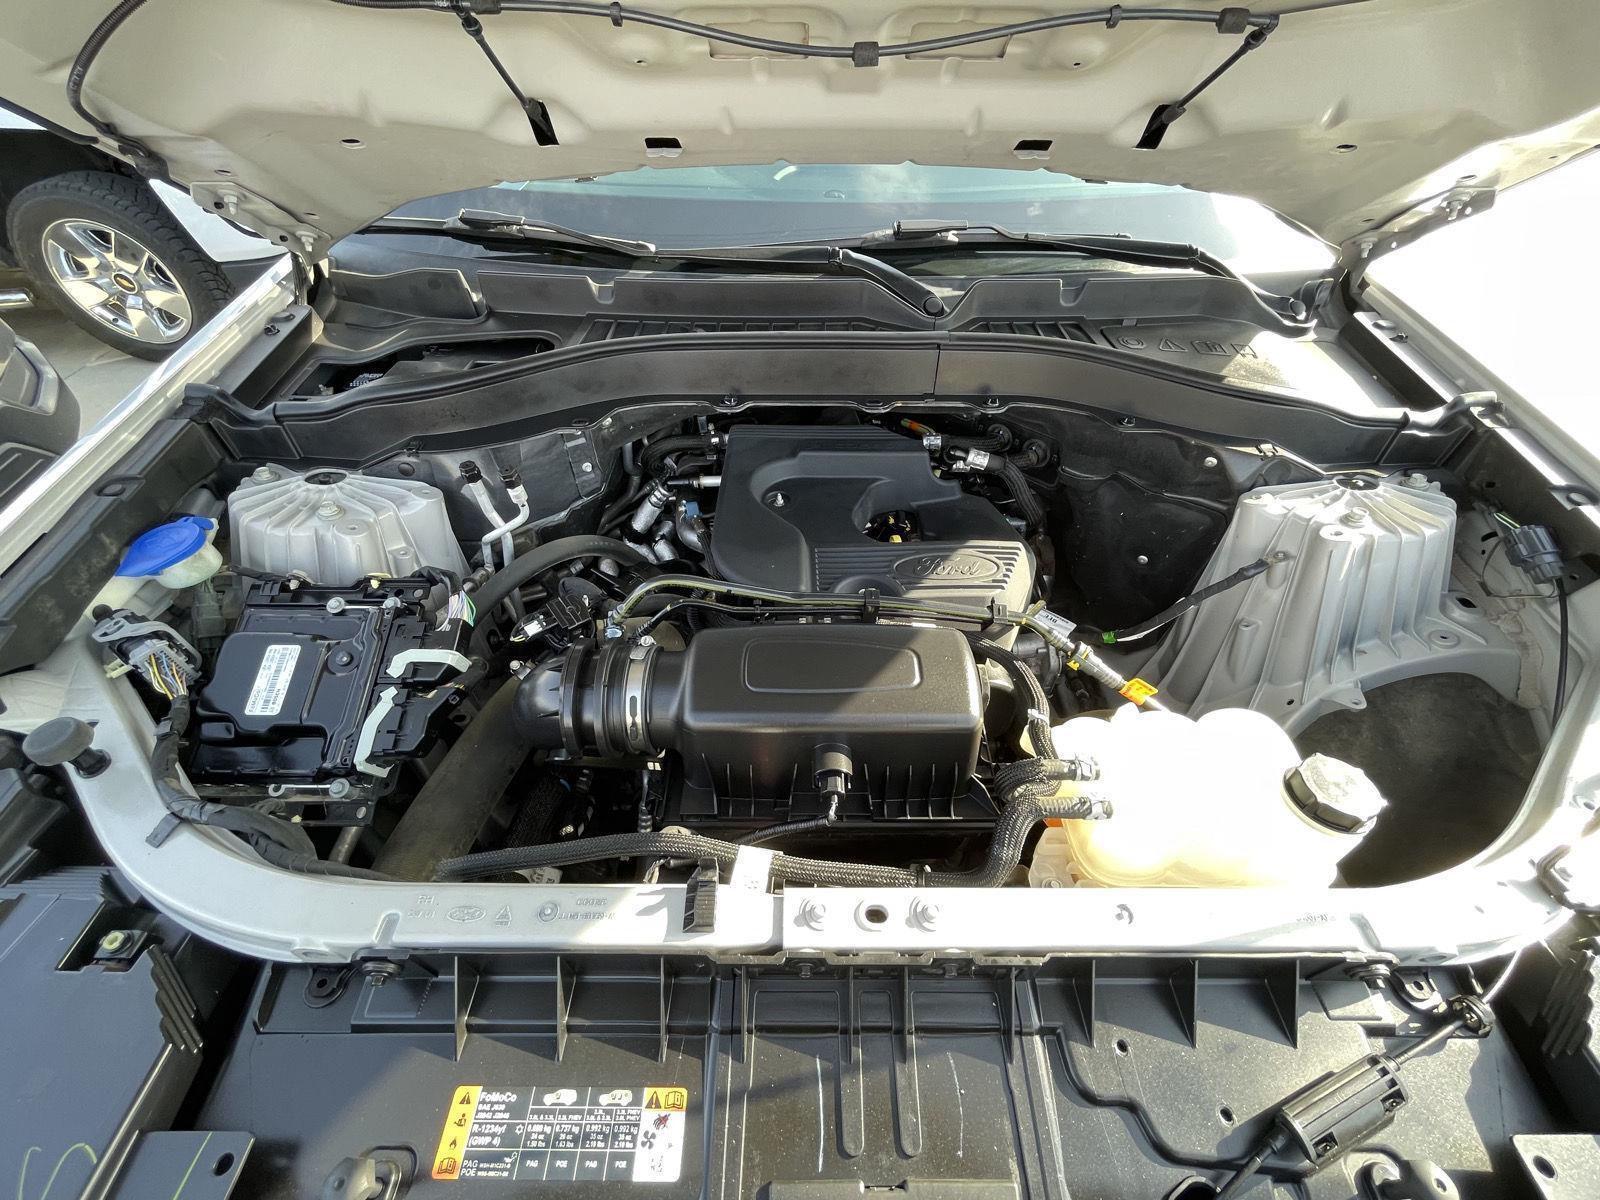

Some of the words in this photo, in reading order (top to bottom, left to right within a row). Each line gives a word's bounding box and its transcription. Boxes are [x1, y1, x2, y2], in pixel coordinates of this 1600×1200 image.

[917, 557, 981, 576] Ford
[480, 1091, 517, 1102] FoMoCo
[472, 1124, 507, 1135] R-1234yf
[544, 1124, 551, 1134] kg
[572, 1124, 580, 1134] kg
[586, 1124, 602, 1132] 0.992
[602, 1124, 610, 1134] kg
[613, 1125, 630, 1133] 0.992
[630, 1125, 639, 1135] kg
[469, 1136, 492, 1147] (GWP
[492, 1136, 501, 1147] 4)
[625, 1141, 634, 1149] lbs
[462, 1160, 479, 1168] PAG
[526, 1160, 539, 1168] PAG
[556, 1160, 568, 1168] POE
[585, 1161, 598, 1169] PAG
[615, 1161, 627, 1169] POE
